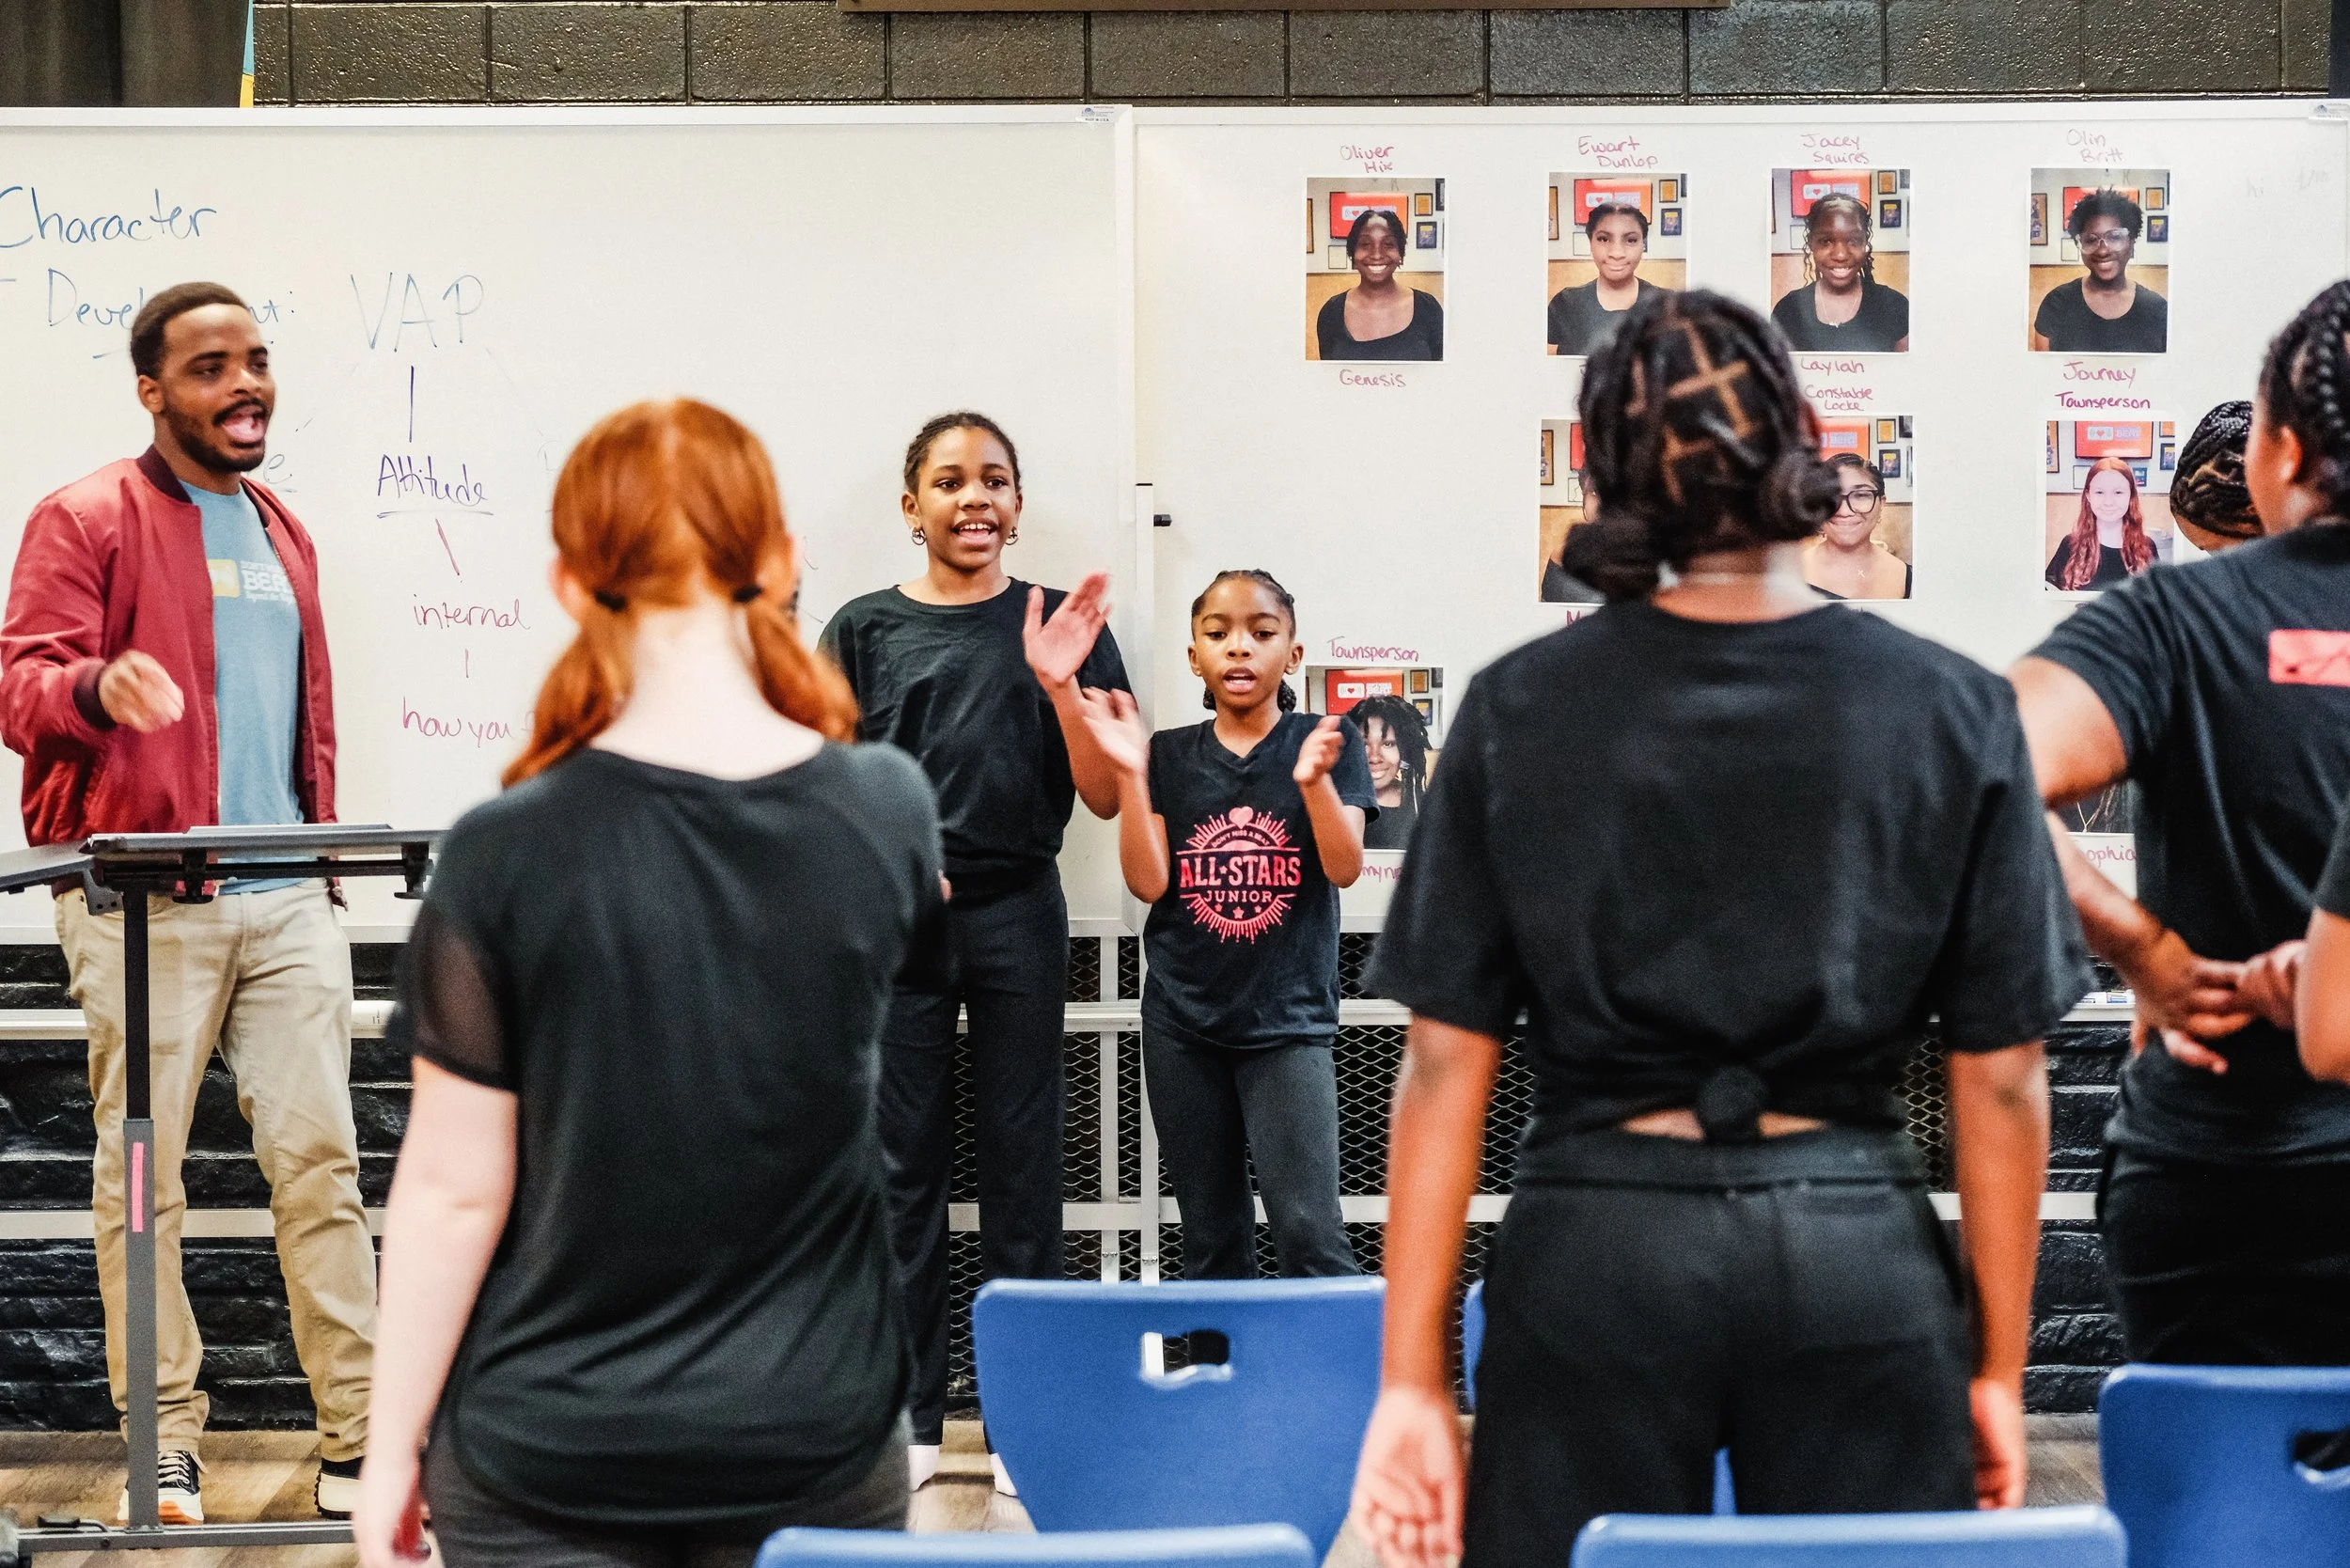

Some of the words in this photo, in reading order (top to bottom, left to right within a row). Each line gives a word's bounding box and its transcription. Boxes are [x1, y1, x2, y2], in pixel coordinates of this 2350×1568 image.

[1577, 134, 1641, 156] Ewart
[1800, 133, 1860, 150] Jacey
[2066, 128, 2107, 147] Olin
[1340, 145, 1395, 161] Oliver
[1596, 153, 1659, 169] Dunlop
[1812, 150, 1871, 165] Squires
[2079, 147, 2123, 163] Britt
[1364, 161, 1394, 174] Hix
[0, 185, 217, 248] Character
[351, 272, 485, 353] VAP
[1800, 356, 1865, 376] Laylah
[2062, 361, 2137, 389] Journey
[1340, 368, 1407, 388] Genesis
[1824, 400, 1865, 412] Locke
[2054, 391, 2151, 410] Townsperson
[378, 454, 488, 507] Attitude
[414, 593, 531, 630] internal
[1326, 635, 1419, 663] Townsperson
[402, 696, 462, 737] how
[468, 721, 516, 748] you
[2083, 844, 2137, 868] ophia
[1204, 889, 1273, 903] JUNIOR
